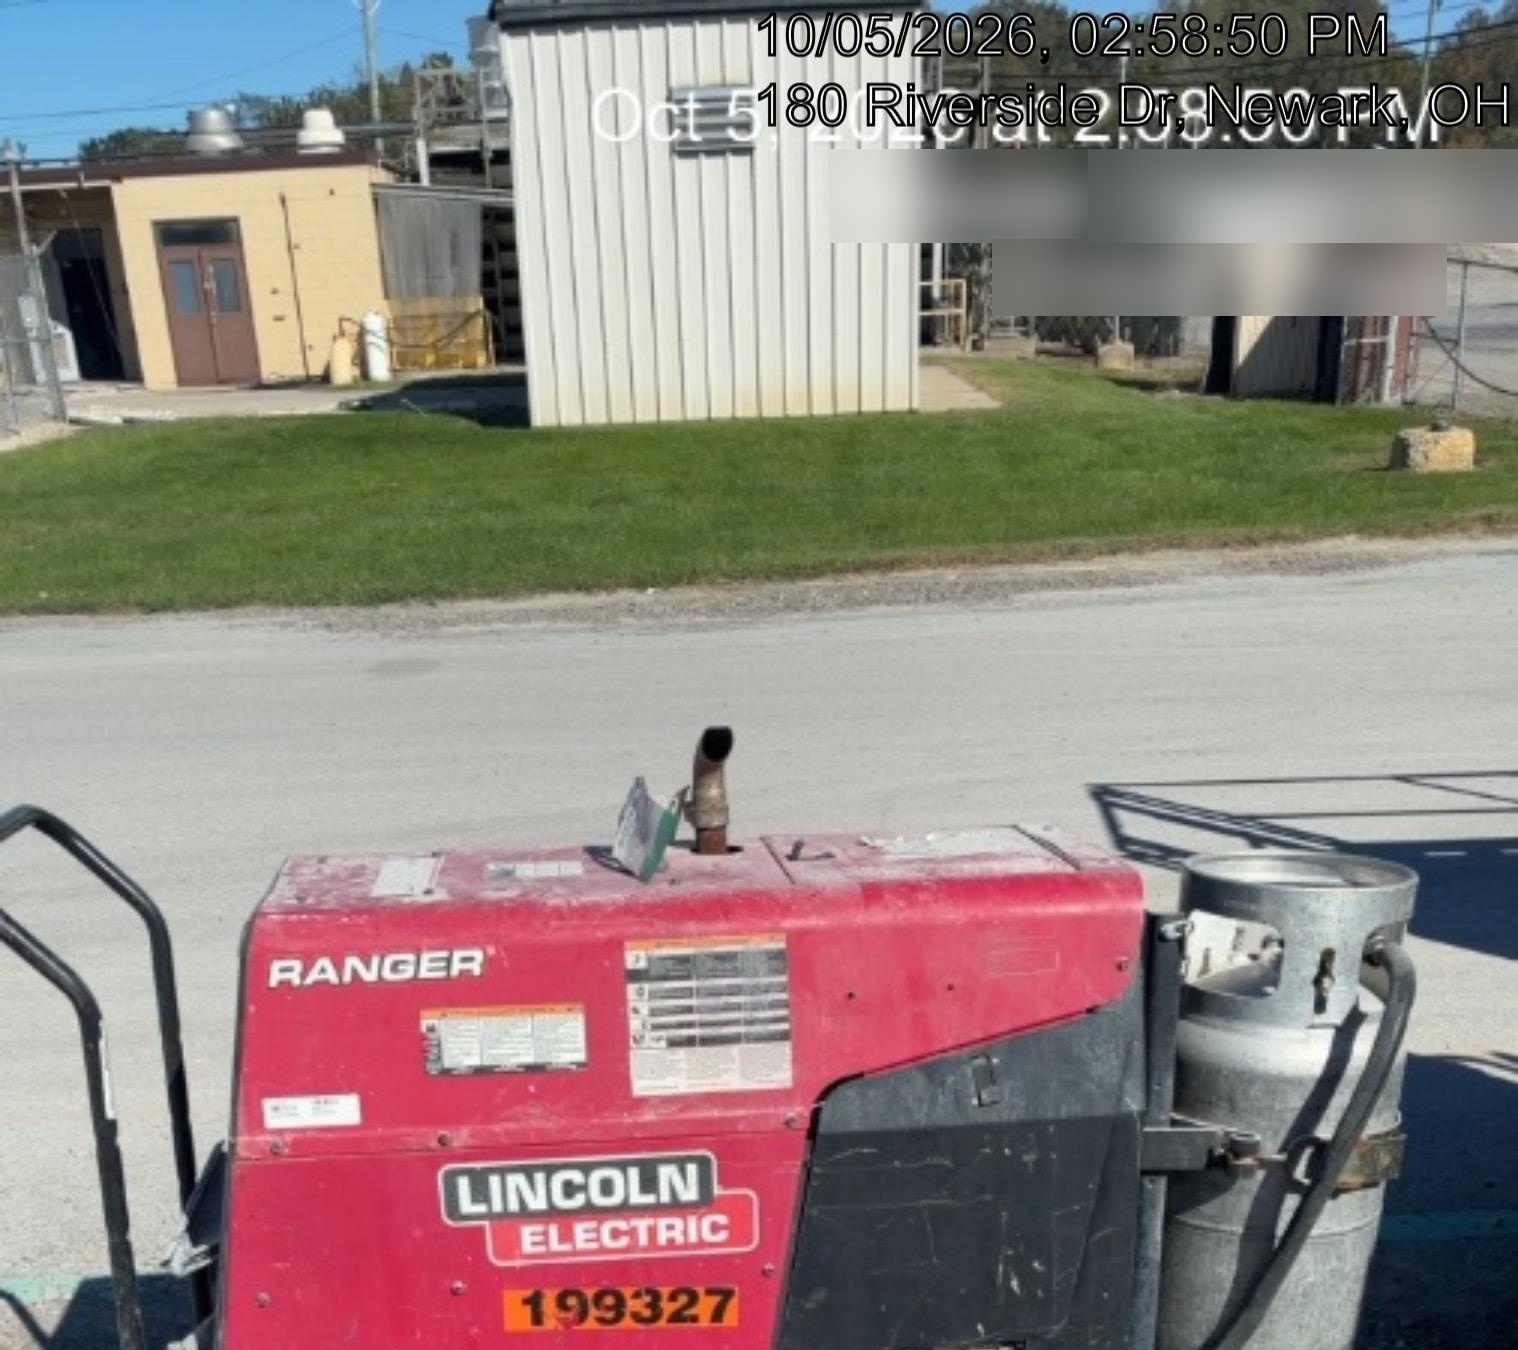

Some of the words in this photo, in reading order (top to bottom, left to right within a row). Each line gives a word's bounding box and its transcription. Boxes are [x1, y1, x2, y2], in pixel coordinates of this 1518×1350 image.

[267, 948, 486, 989] RANGER
[456, 1162, 700, 1216] LINCOLN
[520, 1213, 729, 1255] ELECTRIC
[521, 1286, 736, 1328] 199327
